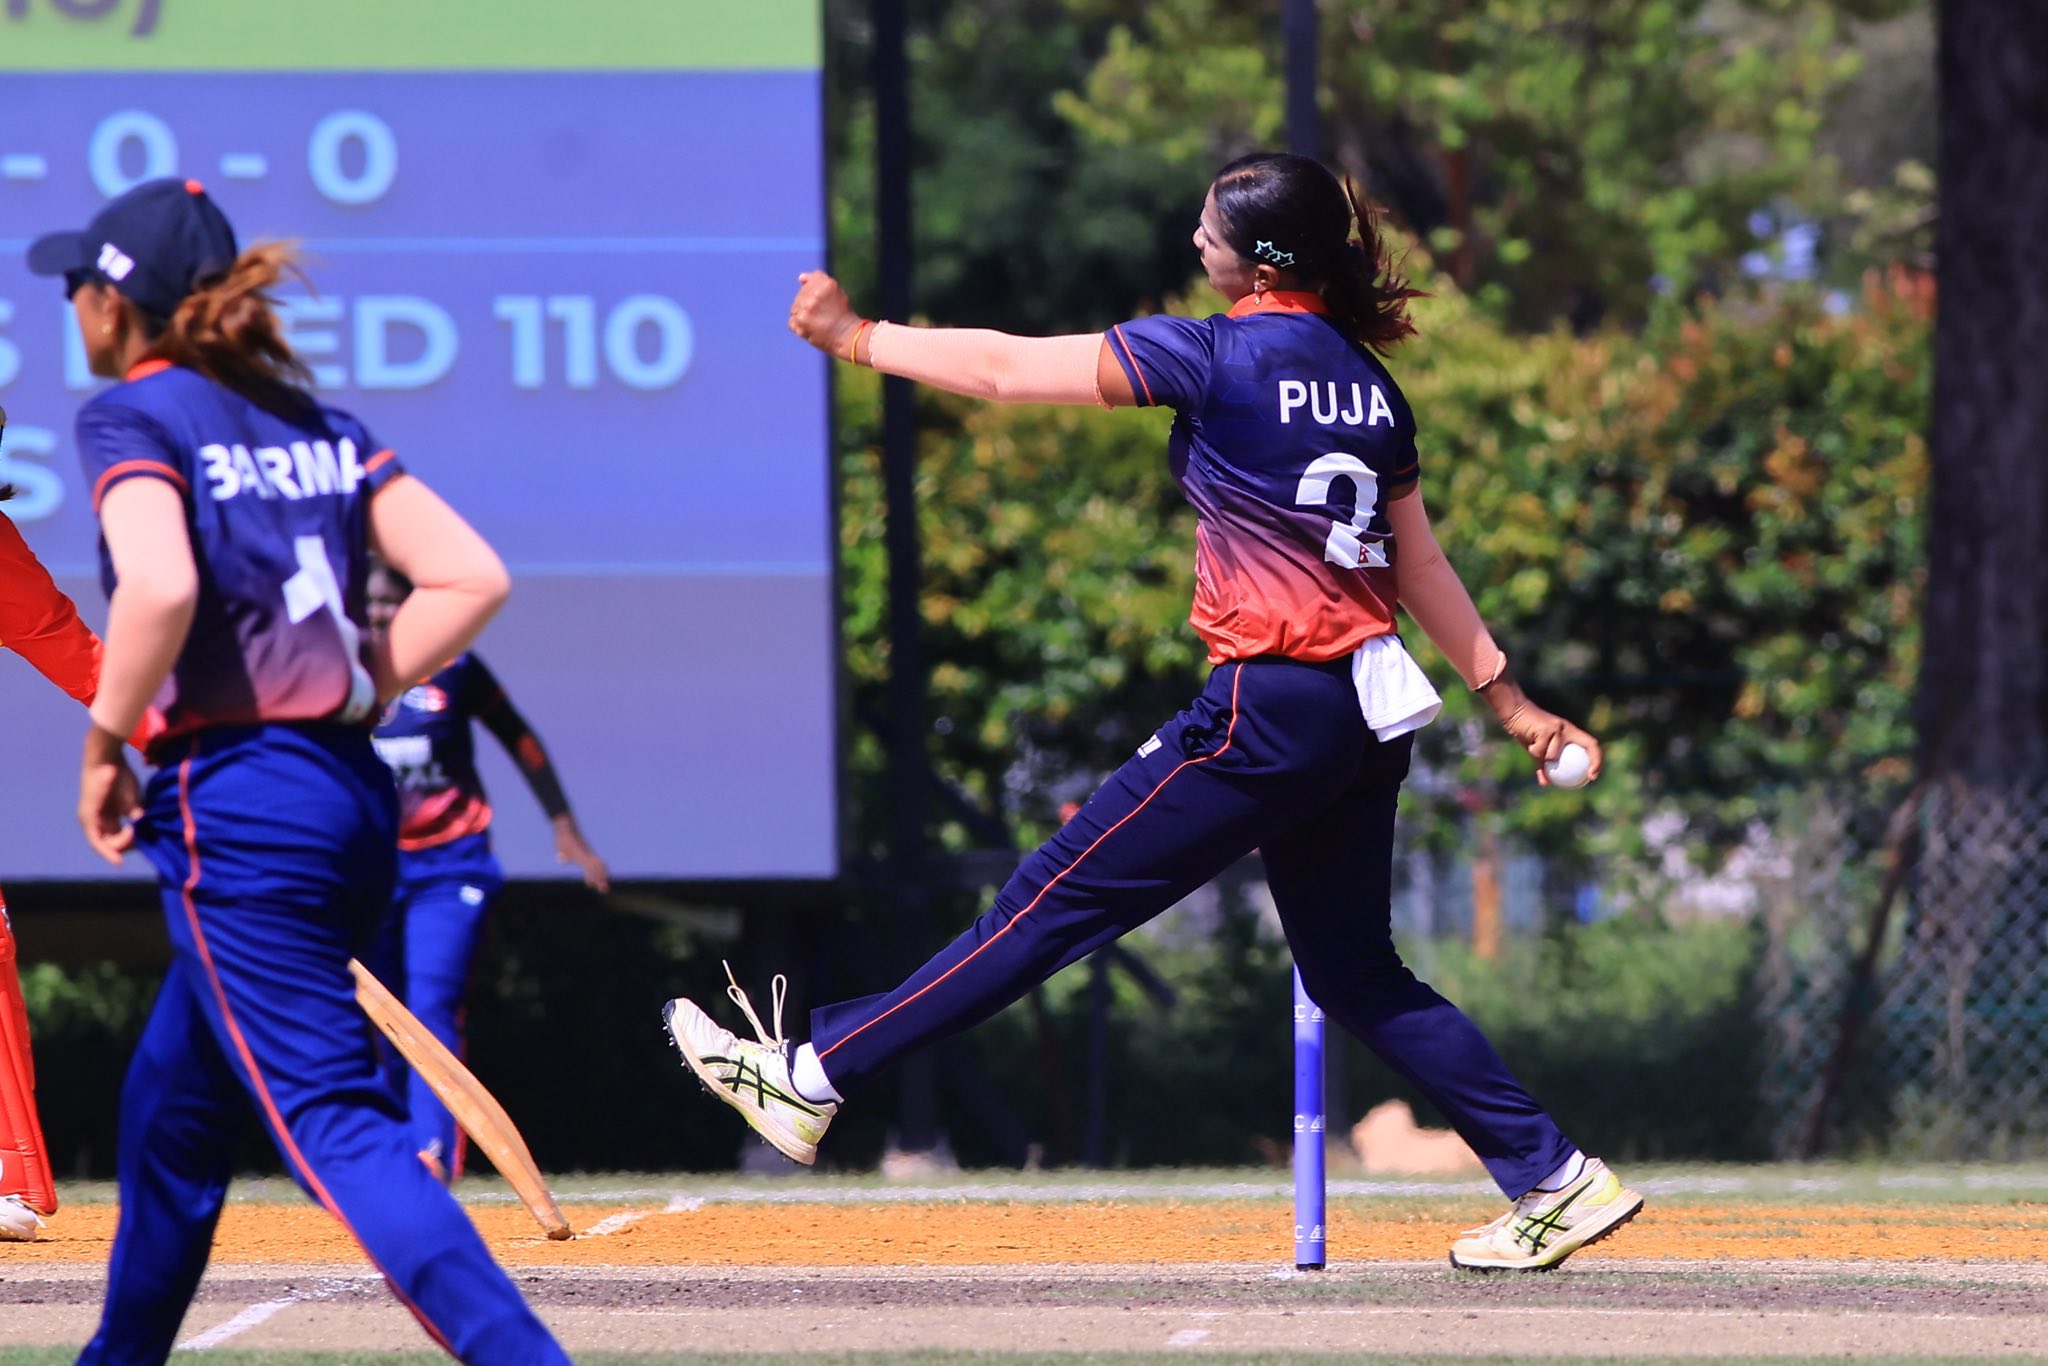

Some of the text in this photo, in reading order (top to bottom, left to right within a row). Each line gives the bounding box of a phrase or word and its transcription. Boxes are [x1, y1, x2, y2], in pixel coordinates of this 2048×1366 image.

[307, 108, 398, 206] 0
[492, 293, 694, 391] 110
[1278, 379, 1395, 428] PUJA
[199, 436, 366, 501] BARMA
[1295, 452, 1390, 570] 2
